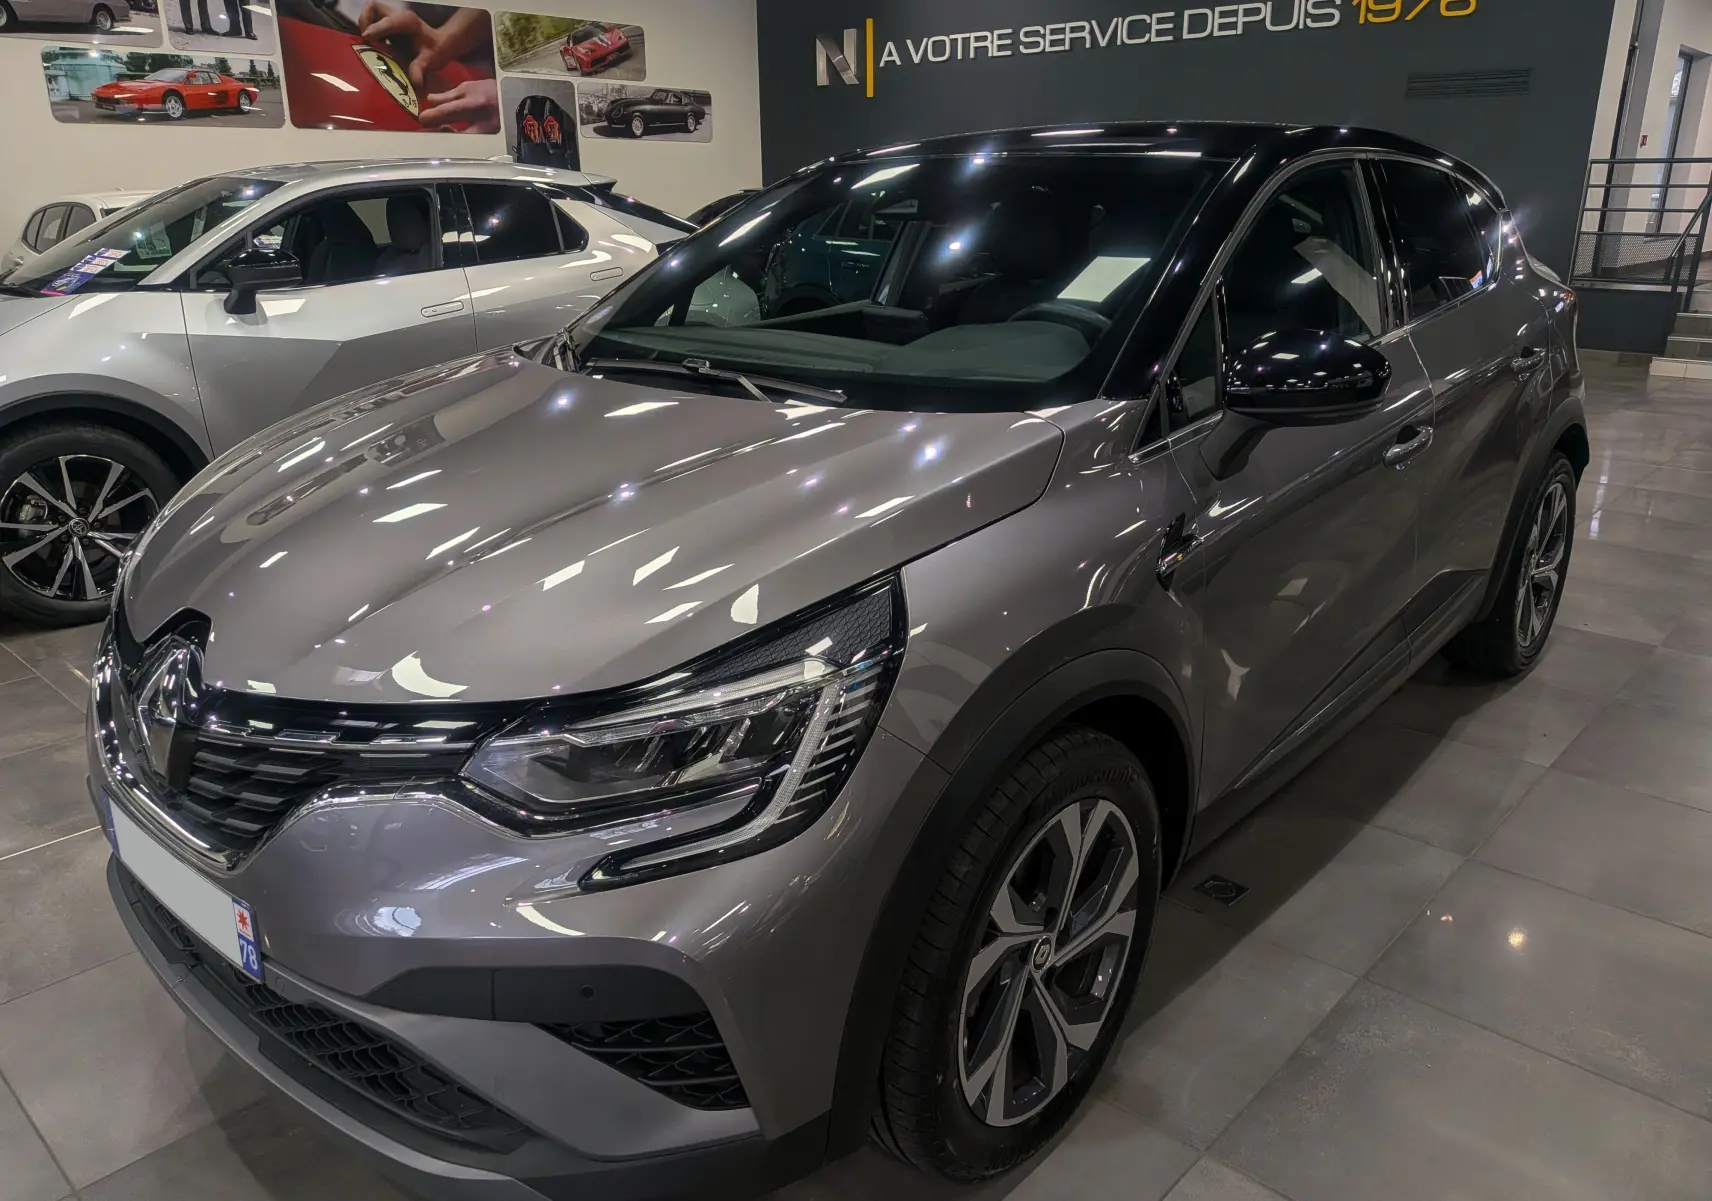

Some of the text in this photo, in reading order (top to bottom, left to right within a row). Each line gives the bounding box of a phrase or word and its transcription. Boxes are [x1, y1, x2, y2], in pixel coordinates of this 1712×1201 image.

[879, 41, 902, 68] A
[906, 28, 1014, 65] VOTRE
[1019, 11, 1177, 55] SERVICE
[1182, 0, 1342, 40] DEPUIS
[239, 938, 258, 970] 78
